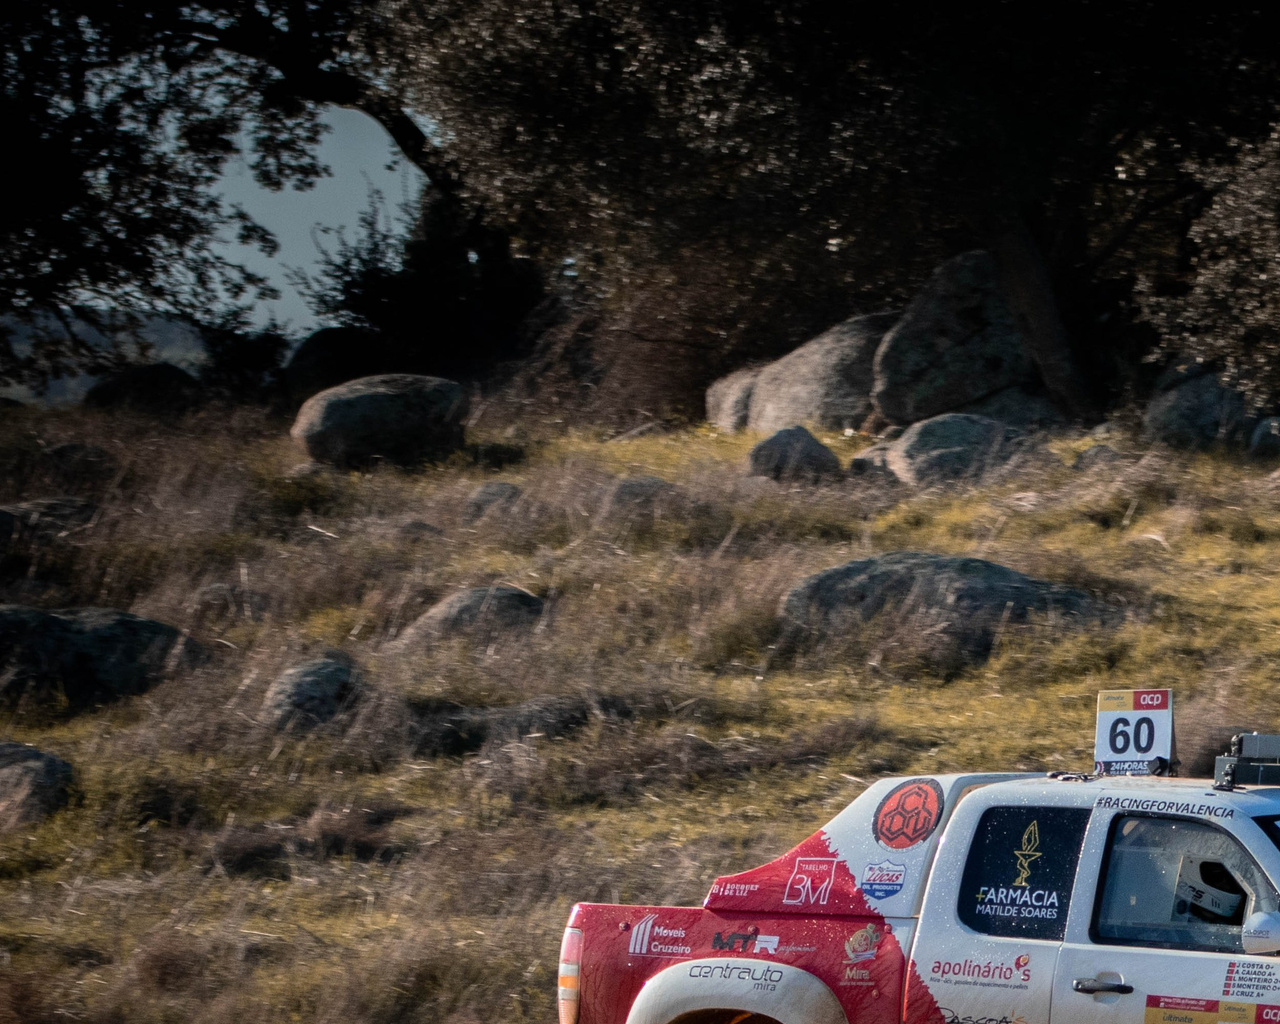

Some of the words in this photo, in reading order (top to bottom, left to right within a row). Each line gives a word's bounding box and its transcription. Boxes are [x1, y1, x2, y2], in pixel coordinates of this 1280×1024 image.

[1140, 694, 1161, 706] acp
[1109, 717, 1155, 755] 60
[1096, 797, 1235, 819] #RACINGFORVALENCIA
[866, 872, 902, 882] LUCAS
[976, 886, 1059, 906] FARMÁCIA
[976, 904, 1018, 917] MATILDE
[1020, 907, 1058, 918] SOARES
[650, 941, 691, 954] Cruzeiro
[711, 932, 779, 954] MTR
[689, 963, 783, 983] centrauto
[845, 966, 870, 980] Mira
[1238, 976, 1273, 984] MONTEIRO
[754, 981, 776, 991] mira
